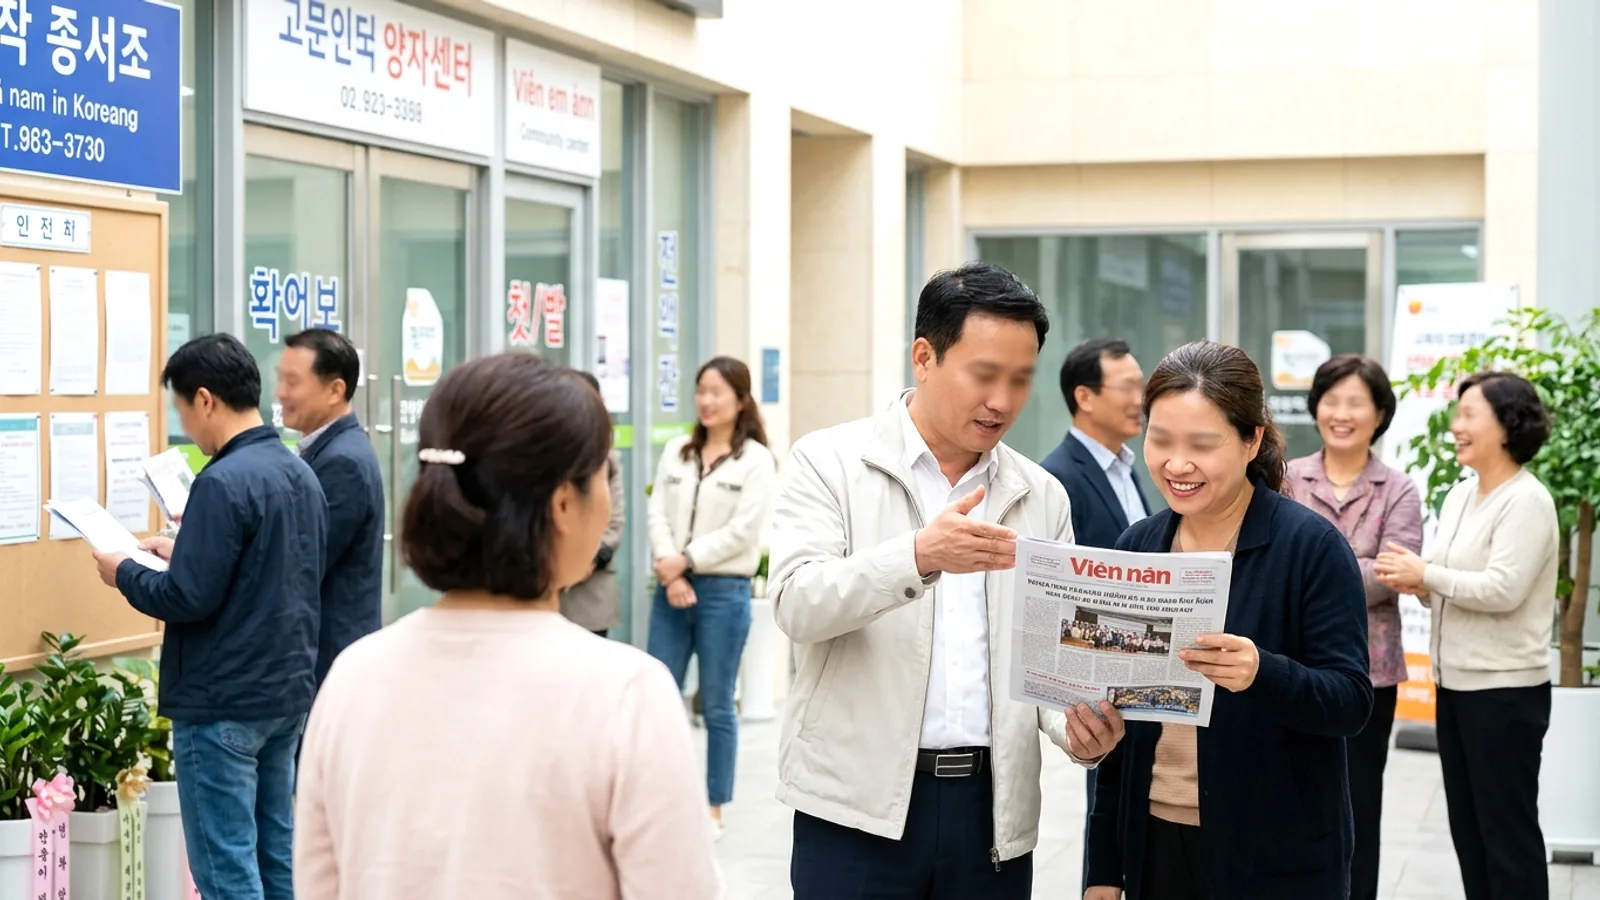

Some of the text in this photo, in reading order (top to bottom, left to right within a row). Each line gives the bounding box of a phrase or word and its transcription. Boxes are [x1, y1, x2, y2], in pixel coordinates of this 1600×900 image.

[46, 4, 151, 83] 종서조
[383, 22, 471, 97] 양자센터
[9, 87, 138, 133] nam in Koreang
[250, 268, 341, 342] 확어보
